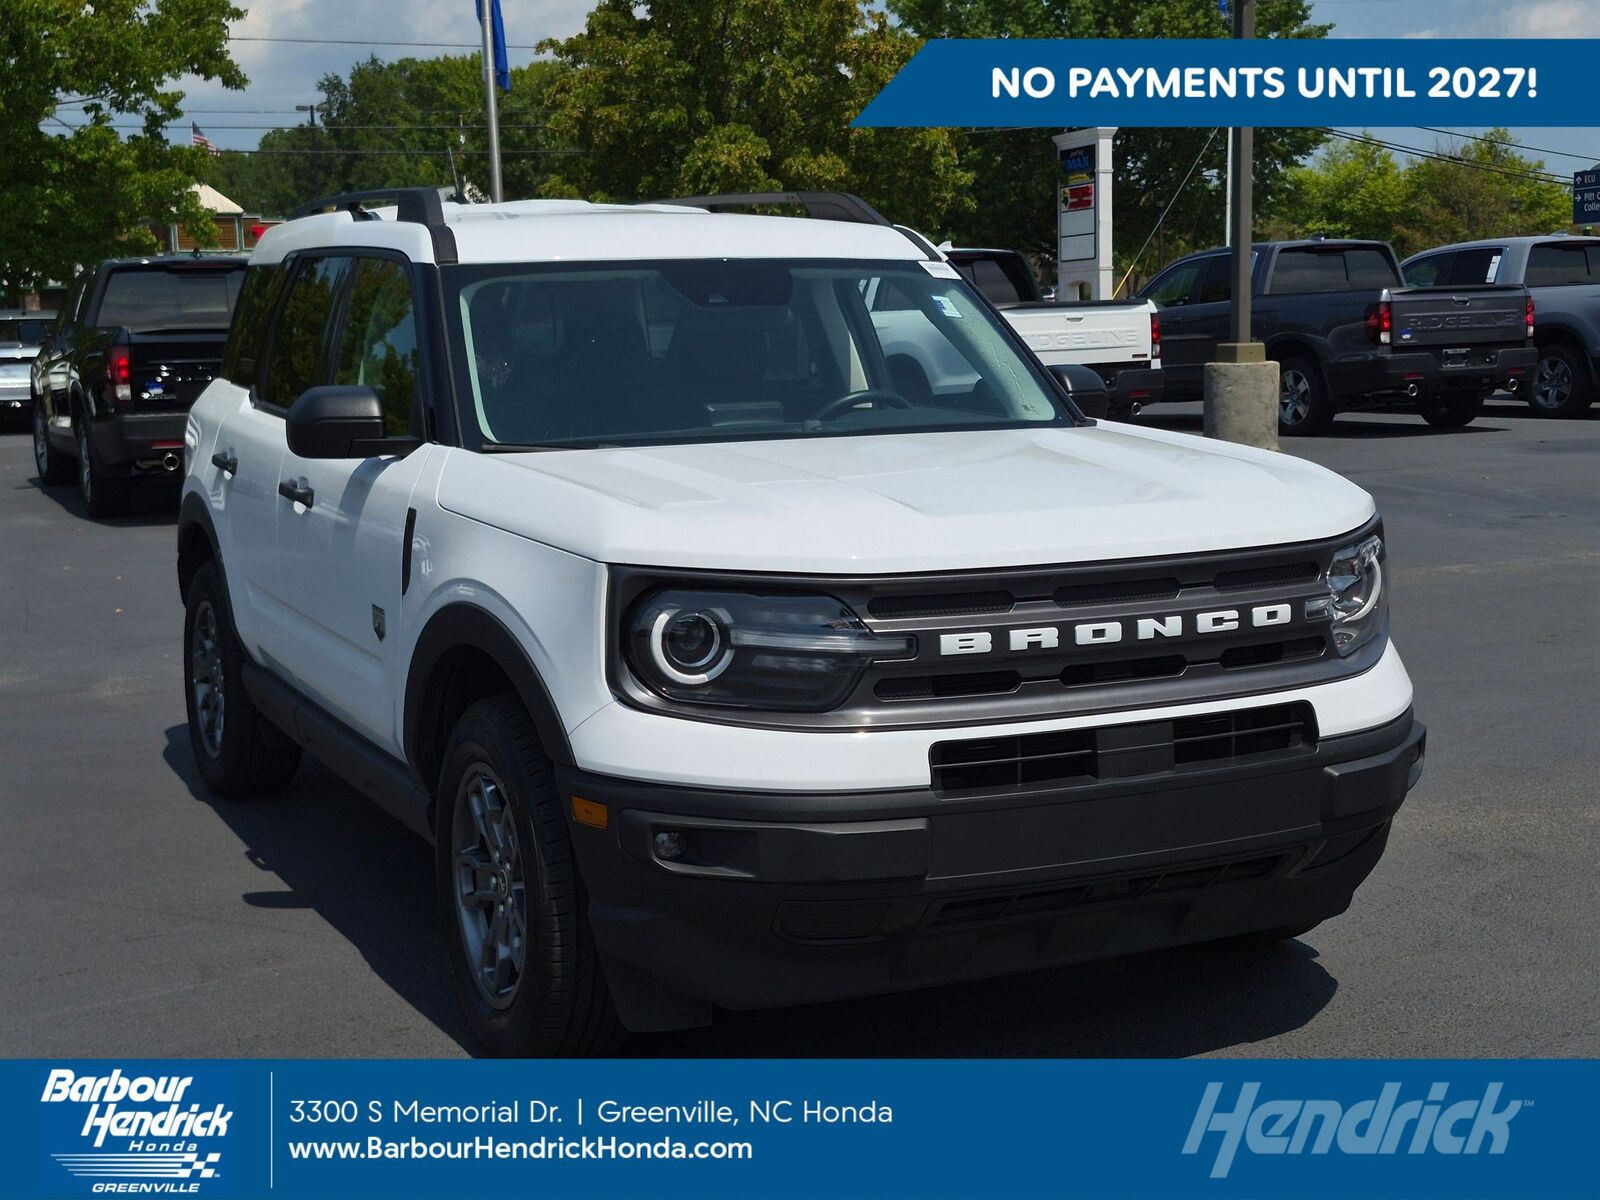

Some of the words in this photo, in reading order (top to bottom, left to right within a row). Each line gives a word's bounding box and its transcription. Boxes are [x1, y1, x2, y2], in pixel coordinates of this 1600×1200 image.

[1584, 174, 1596, 183] ECU
[1408, 313, 1516, 330] RIDGELINE
[939, 603, 1292, 656] BRONCO
